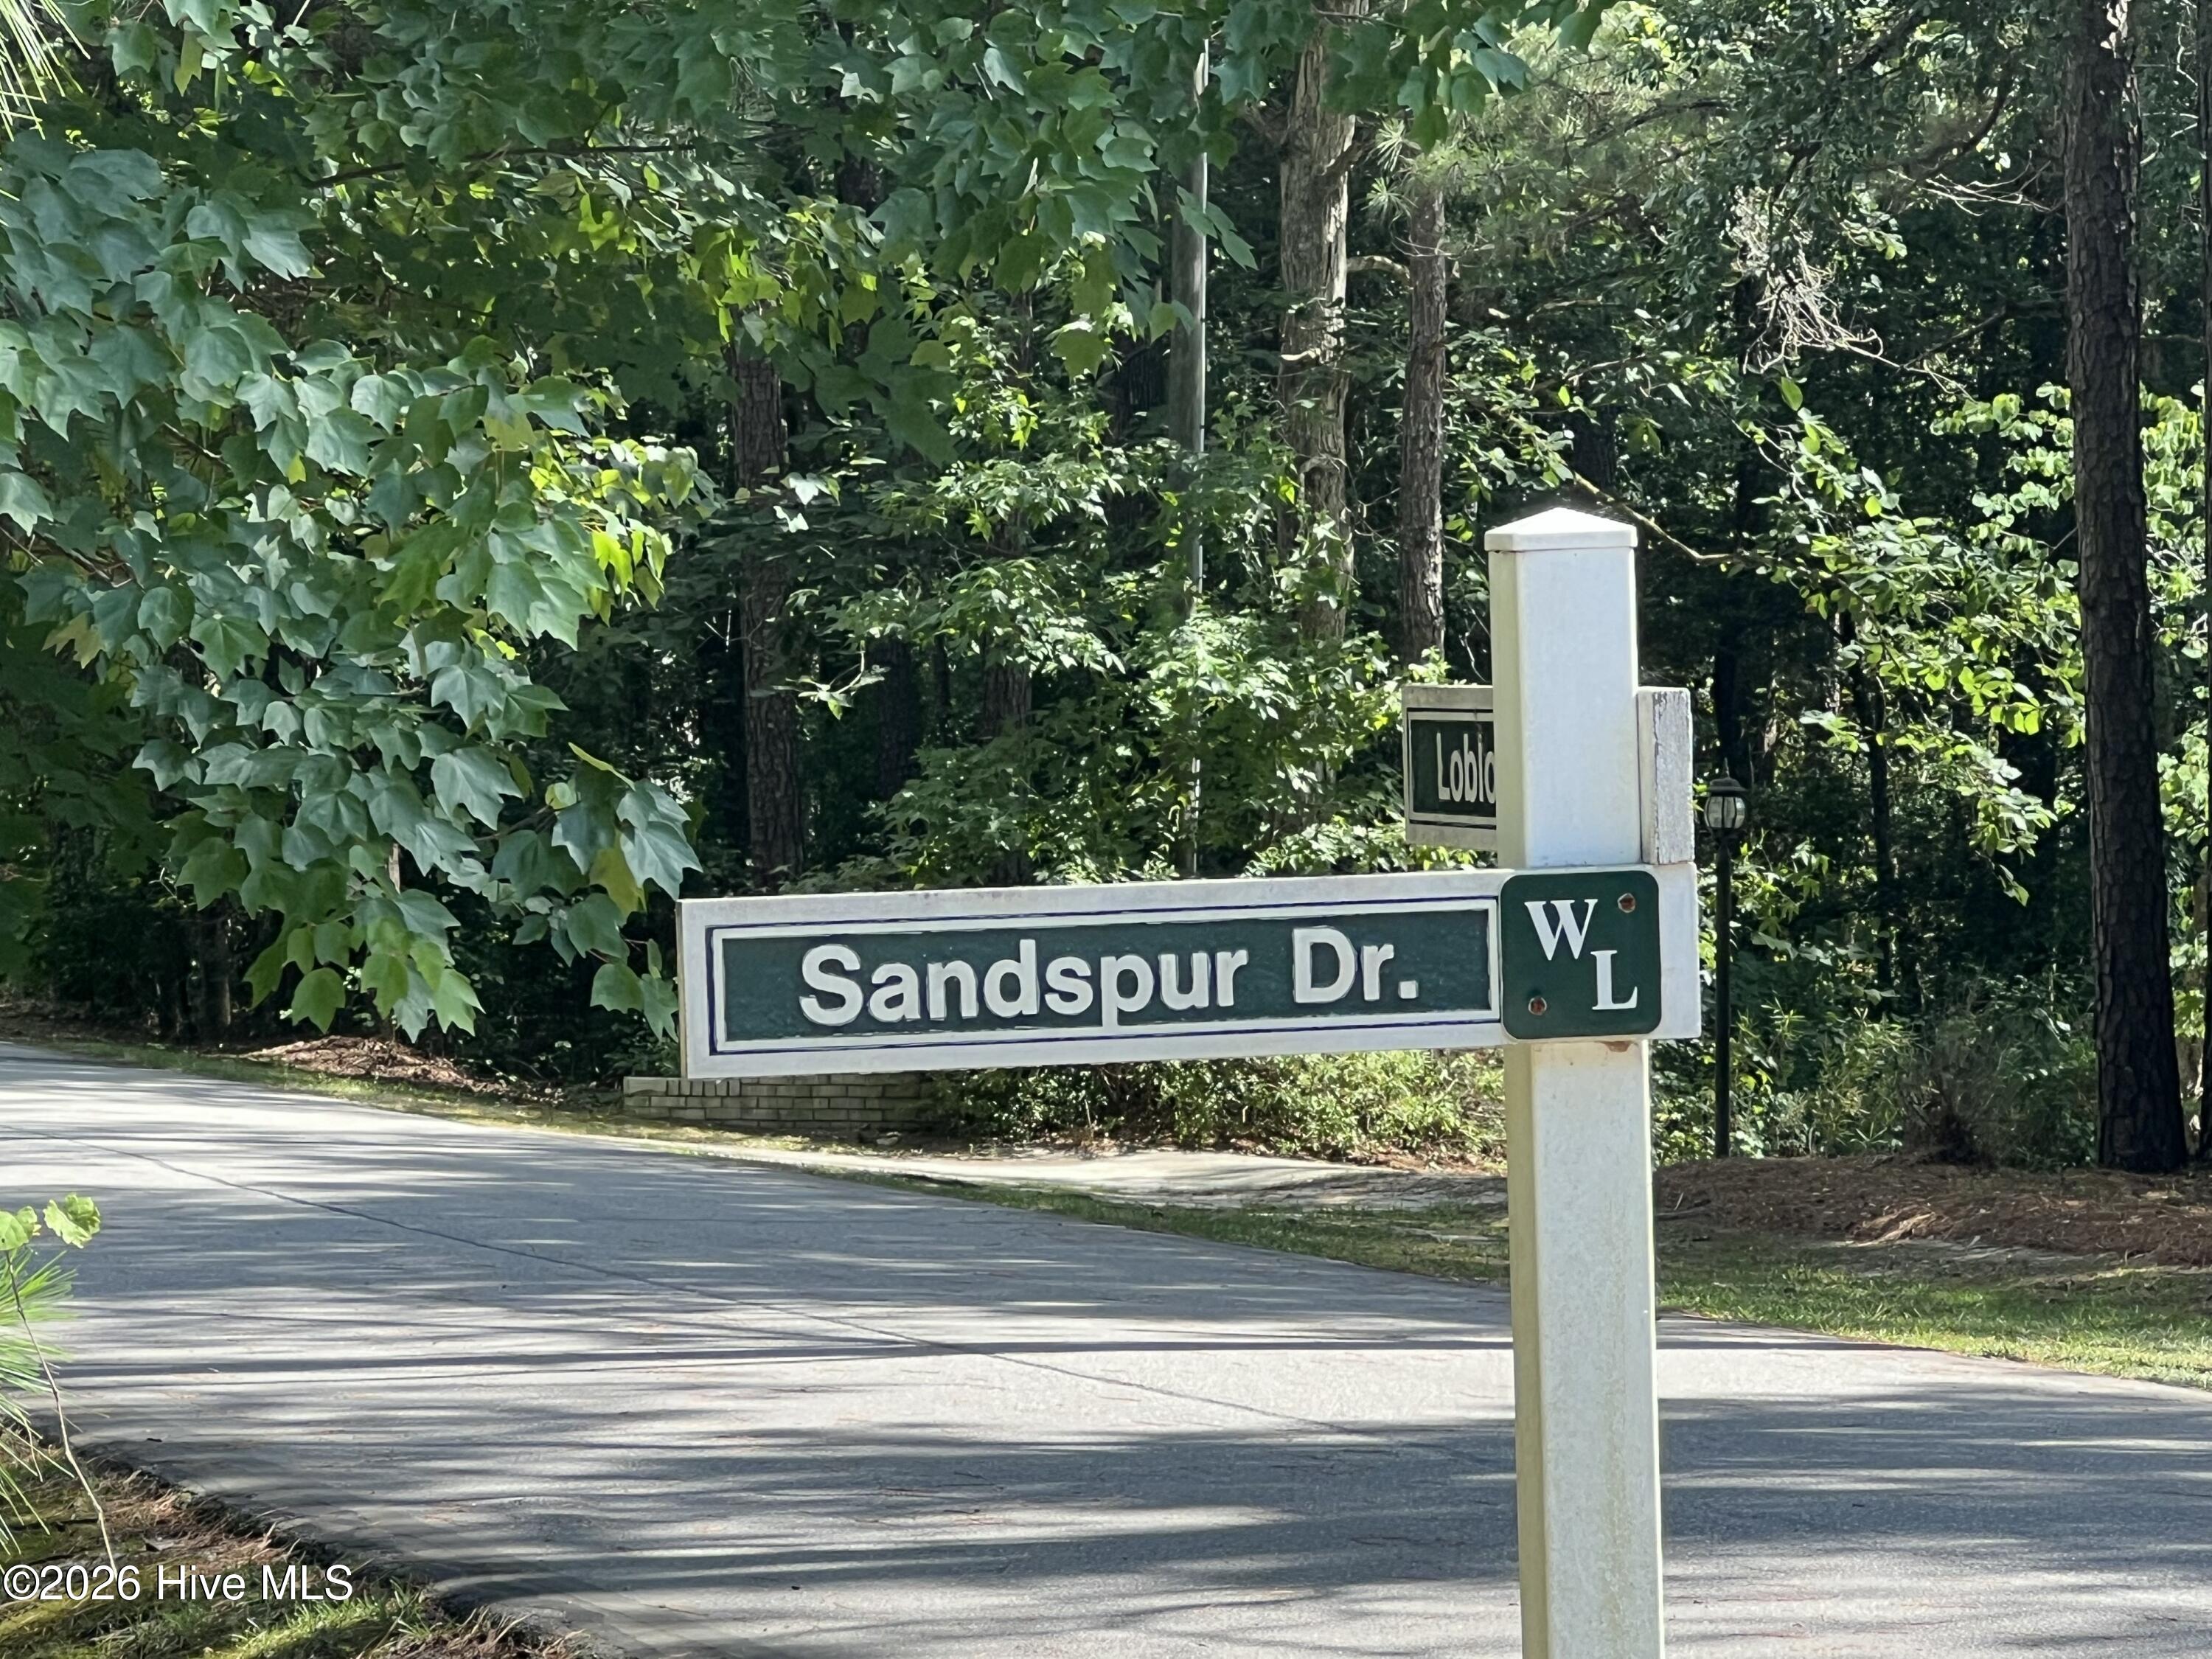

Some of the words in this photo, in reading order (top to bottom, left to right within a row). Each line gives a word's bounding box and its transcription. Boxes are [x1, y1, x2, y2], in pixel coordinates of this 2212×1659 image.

[1524, 899, 1599, 961] W
[799, 938, 1248, 1026] Sandspur
[1292, 925, 1419, 1004] Dr.
[1590, 950, 1638, 1010] L
